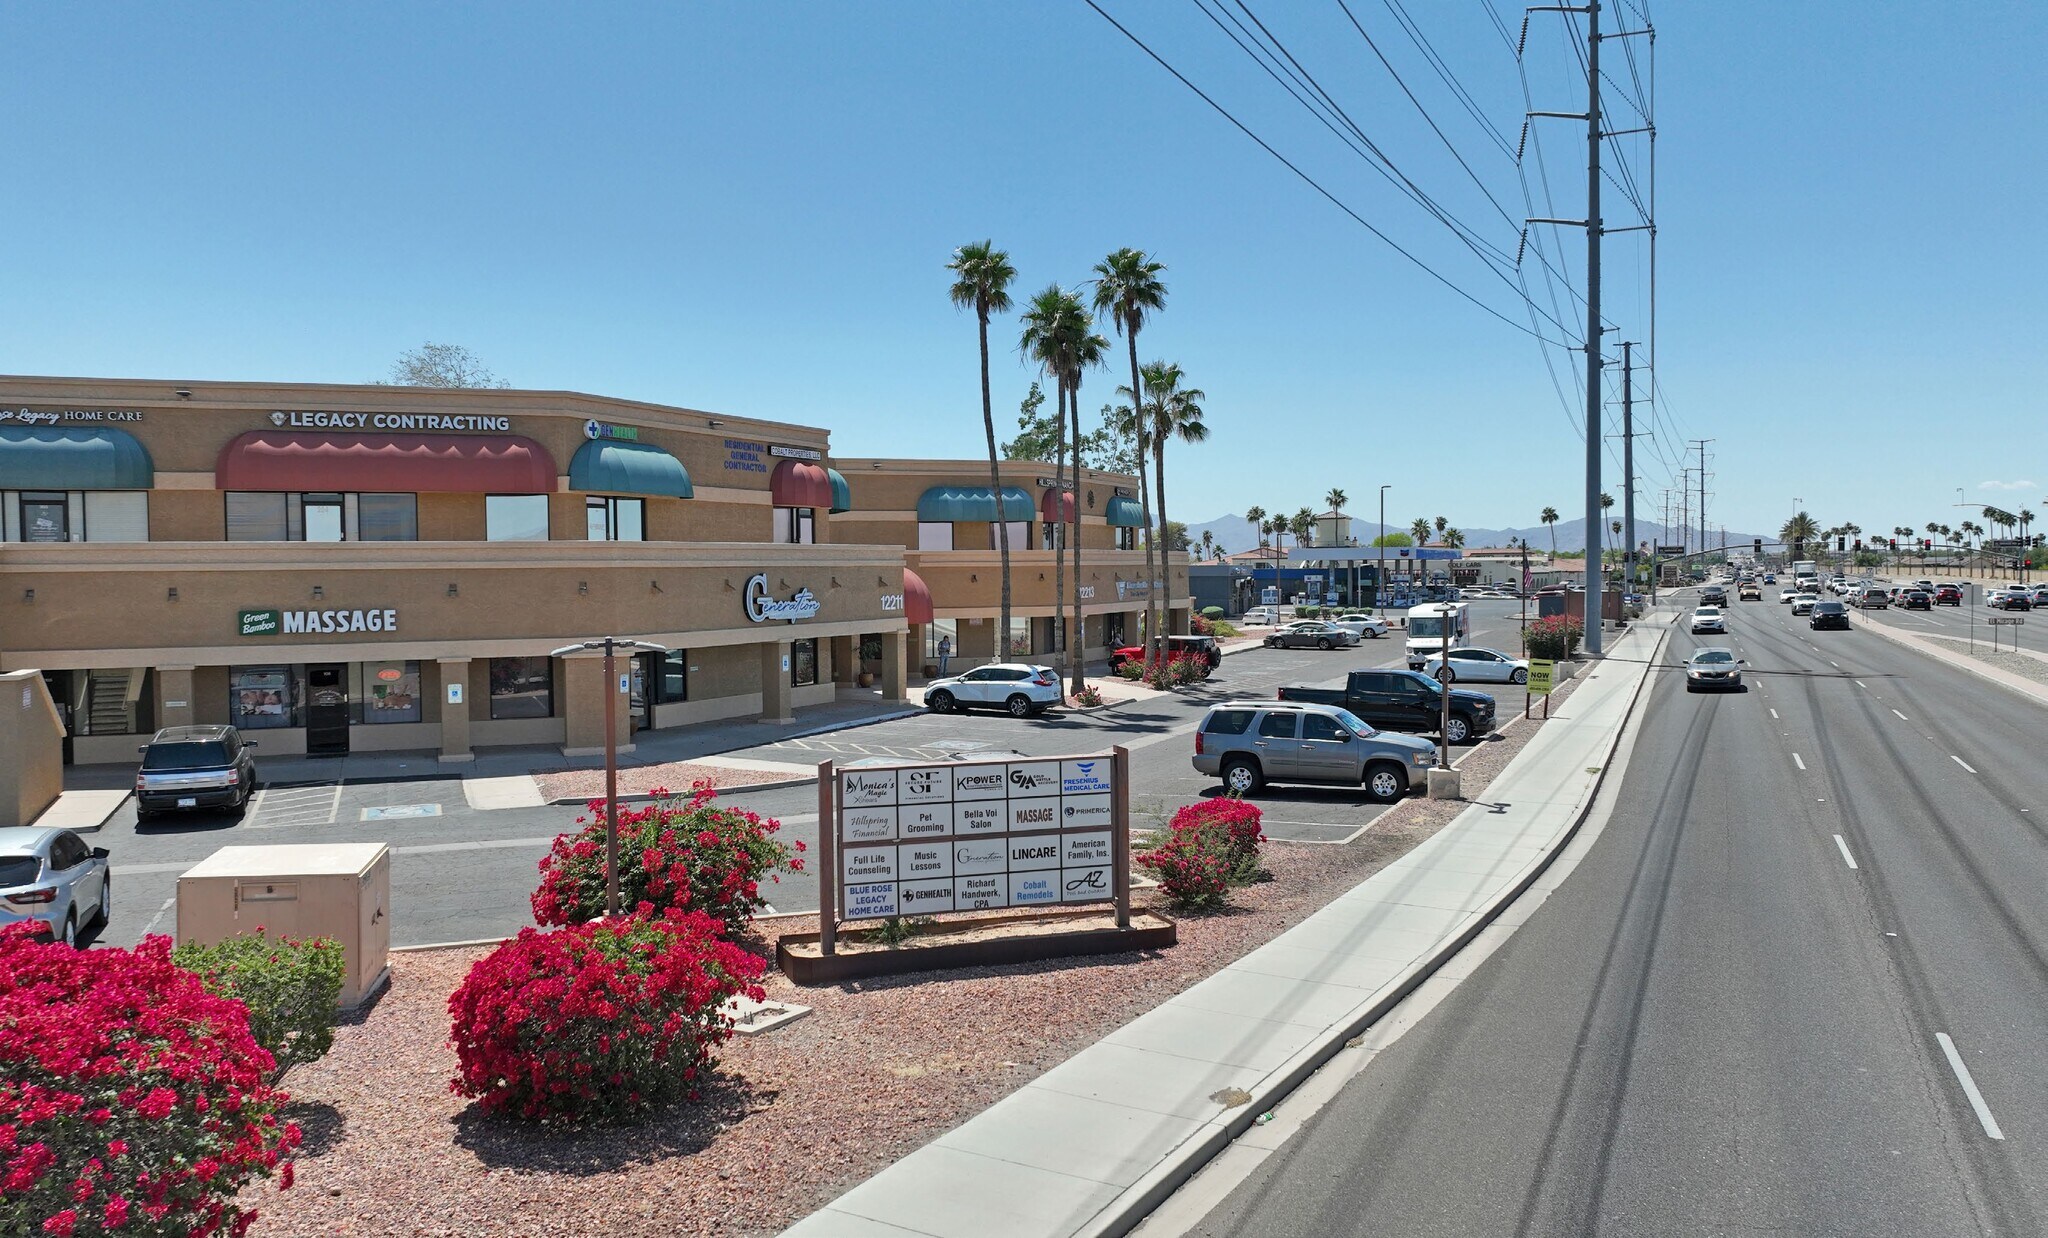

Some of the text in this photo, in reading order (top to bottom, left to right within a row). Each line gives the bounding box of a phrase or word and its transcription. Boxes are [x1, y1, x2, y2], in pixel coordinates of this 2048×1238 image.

[0, 408, 143, 424] se Legacy HOME CARE
[290, 412, 510, 431] LEGACY CONTRACTING
[724, 439, 765, 452] RESIDENTIAL
[772, 447, 787, 455] COBALT
[731, 451, 759, 462] GENERAL
[724, 461, 767, 473] CONTRACTOR
[745, 573, 821, 624] Generation
[880, 594, 904, 611] 12211
[243, 612, 270, 624] Green
[283, 609, 397, 633] MASSAGE
[243, 621, 276, 634] Bamboo
[845, 775, 894, 794] Monica's
[864, 789, 887, 797] Magic
[965, 809, 997, 819] Bella Voi
[1016, 808, 1053, 823] MASSAGE
[1076, 807, 1110, 815] PRIMERICA
[851, 815, 888, 828] Hillspring
[919, 813, 932, 821] Pet
[907, 823, 944, 833] Grooming
[970, 820, 992, 828] Salon
[852, 826, 889, 838] Financial
[1072, 840, 1105, 849] American
[914, 851, 937, 860] Music
[1012, 847, 1056, 860] LINCARE
[1068, 849, 1110, 859] Family, Ins.
[853, 855, 885, 864] Full Life
[848, 865, 891, 875] Counseling
[910, 862, 941, 871] Lessons
[967, 879, 996, 888] Richard
[1023, 880, 1047, 890] Cobalt
[1066, 870, 1107, 891] AZ
[849, 884, 892, 894] BLUE ROSE
[915, 889, 952, 899] GENHEALTH
[961, 889, 1001, 899] Handwerk,
[856, 895, 887, 905] LEGACY
[1017, 891, 1054, 900] Remodels
[974, 900, 989, 909] CPA
[848, 905, 895, 916] HOME CARE
